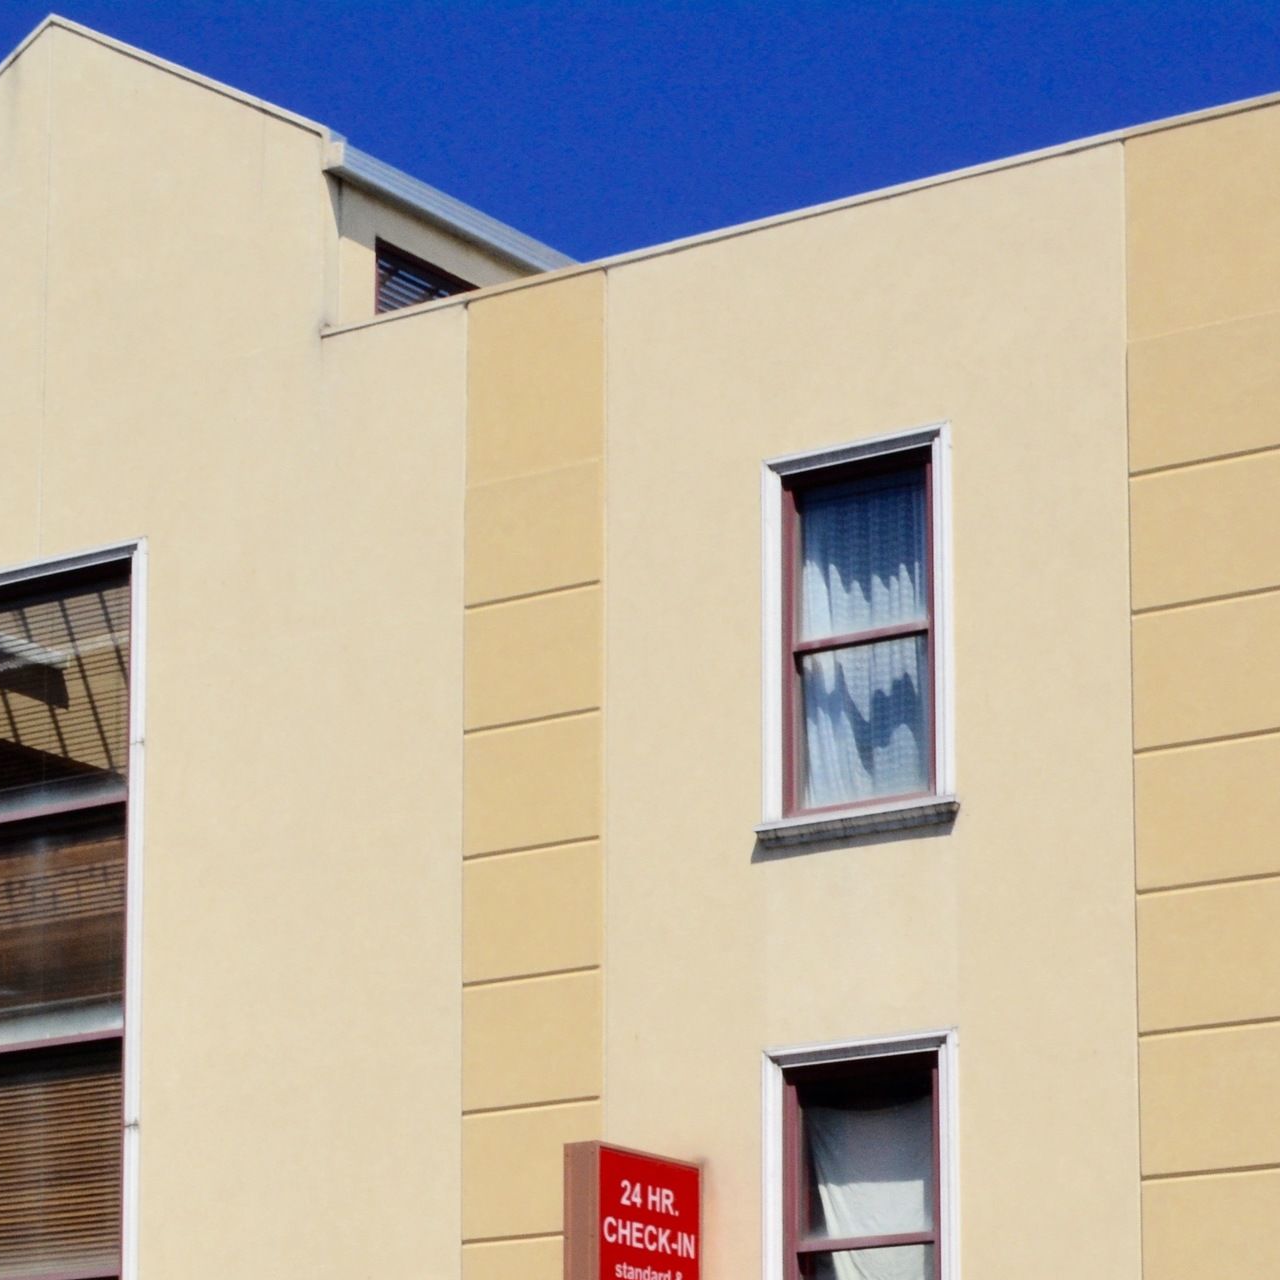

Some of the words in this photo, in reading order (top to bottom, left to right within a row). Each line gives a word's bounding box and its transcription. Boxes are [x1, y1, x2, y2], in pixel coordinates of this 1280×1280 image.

[620, 1179, 642, 1208] 24
[647, 1185, 679, 1217] HR.
[603, 1216, 695, 1259] CHECK-IN
